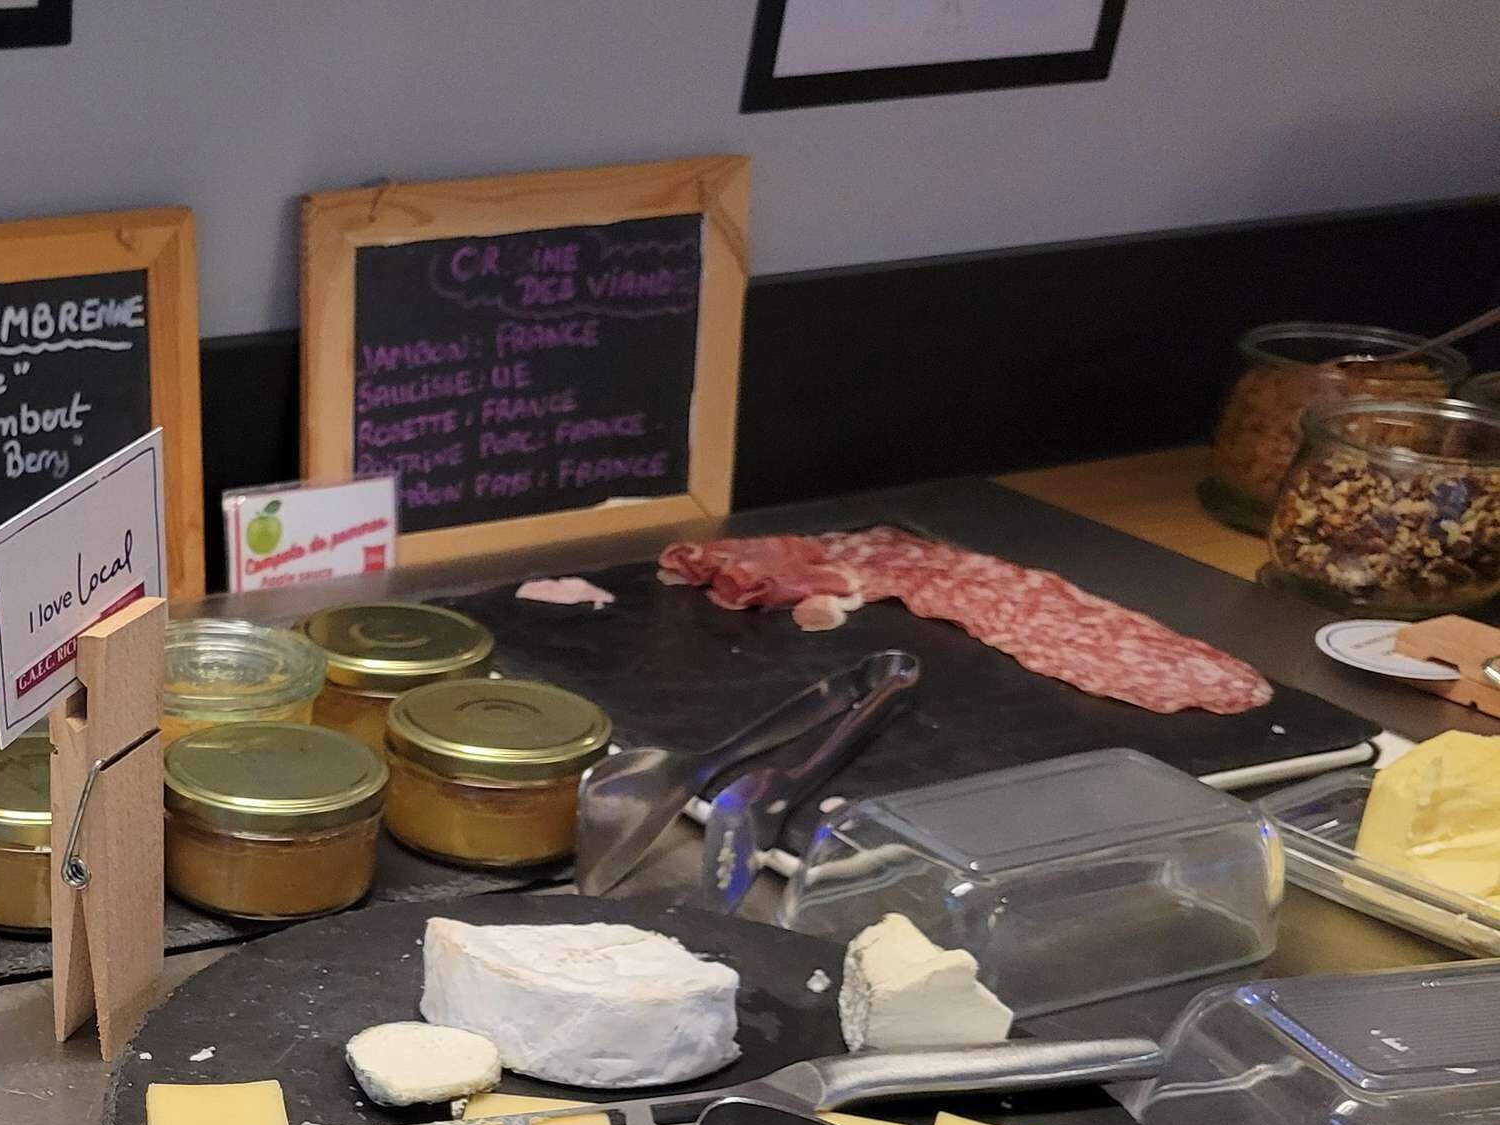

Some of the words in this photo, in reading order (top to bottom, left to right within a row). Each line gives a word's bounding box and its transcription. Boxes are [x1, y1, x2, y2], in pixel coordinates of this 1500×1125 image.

[28, 610, 35, 634] I
[37, 590, 74, 628] love
[76, 528, 134, 606] Local
